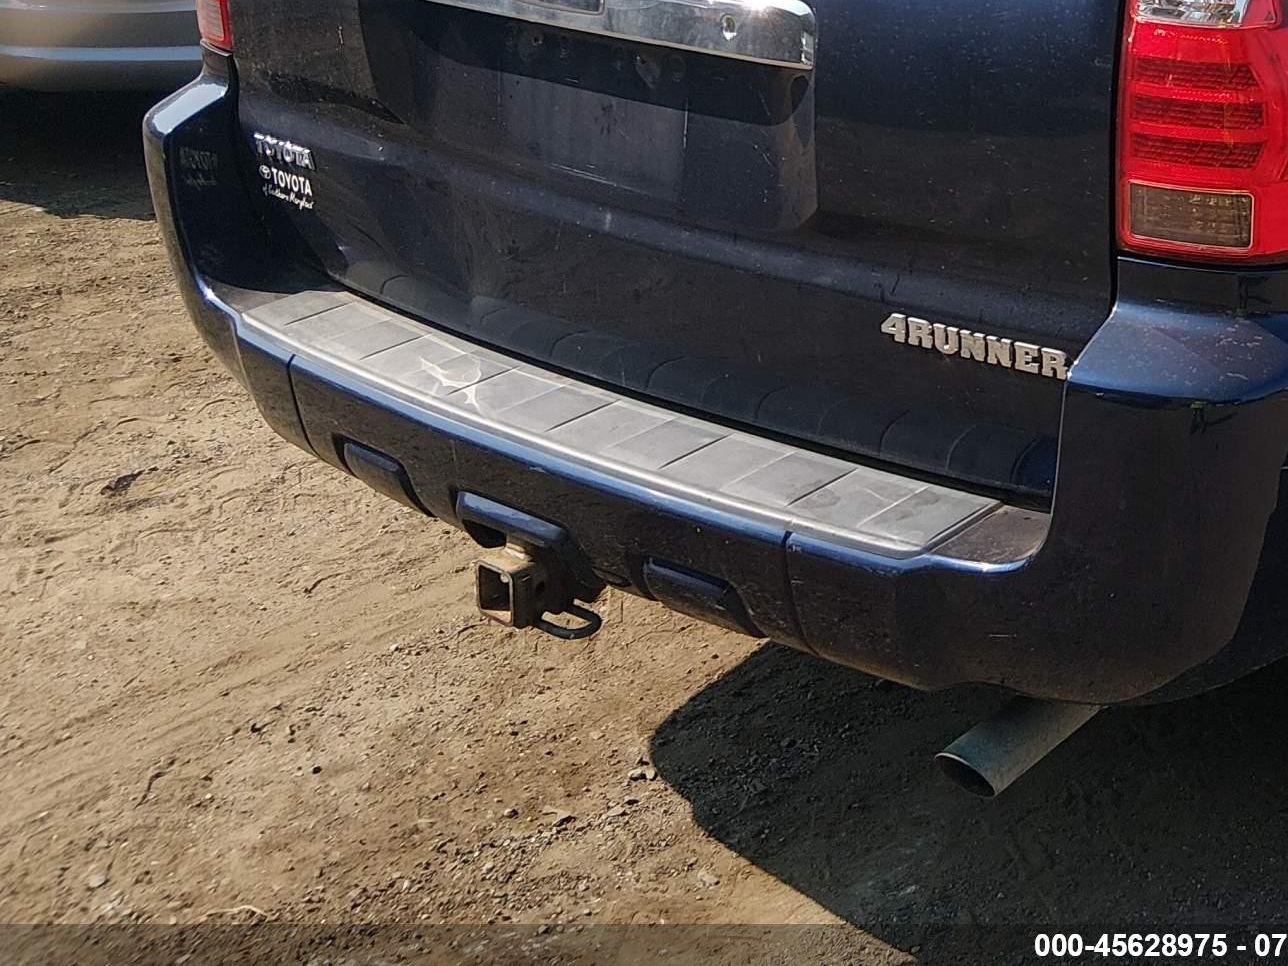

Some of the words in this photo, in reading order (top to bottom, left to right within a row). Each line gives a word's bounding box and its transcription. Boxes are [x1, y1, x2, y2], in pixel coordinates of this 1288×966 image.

[253, 132, 315, 171] TOYOTA
[271, 167, 313, 197] TOYOTA
[880, 312, 1069, 381] 4RUNNER
